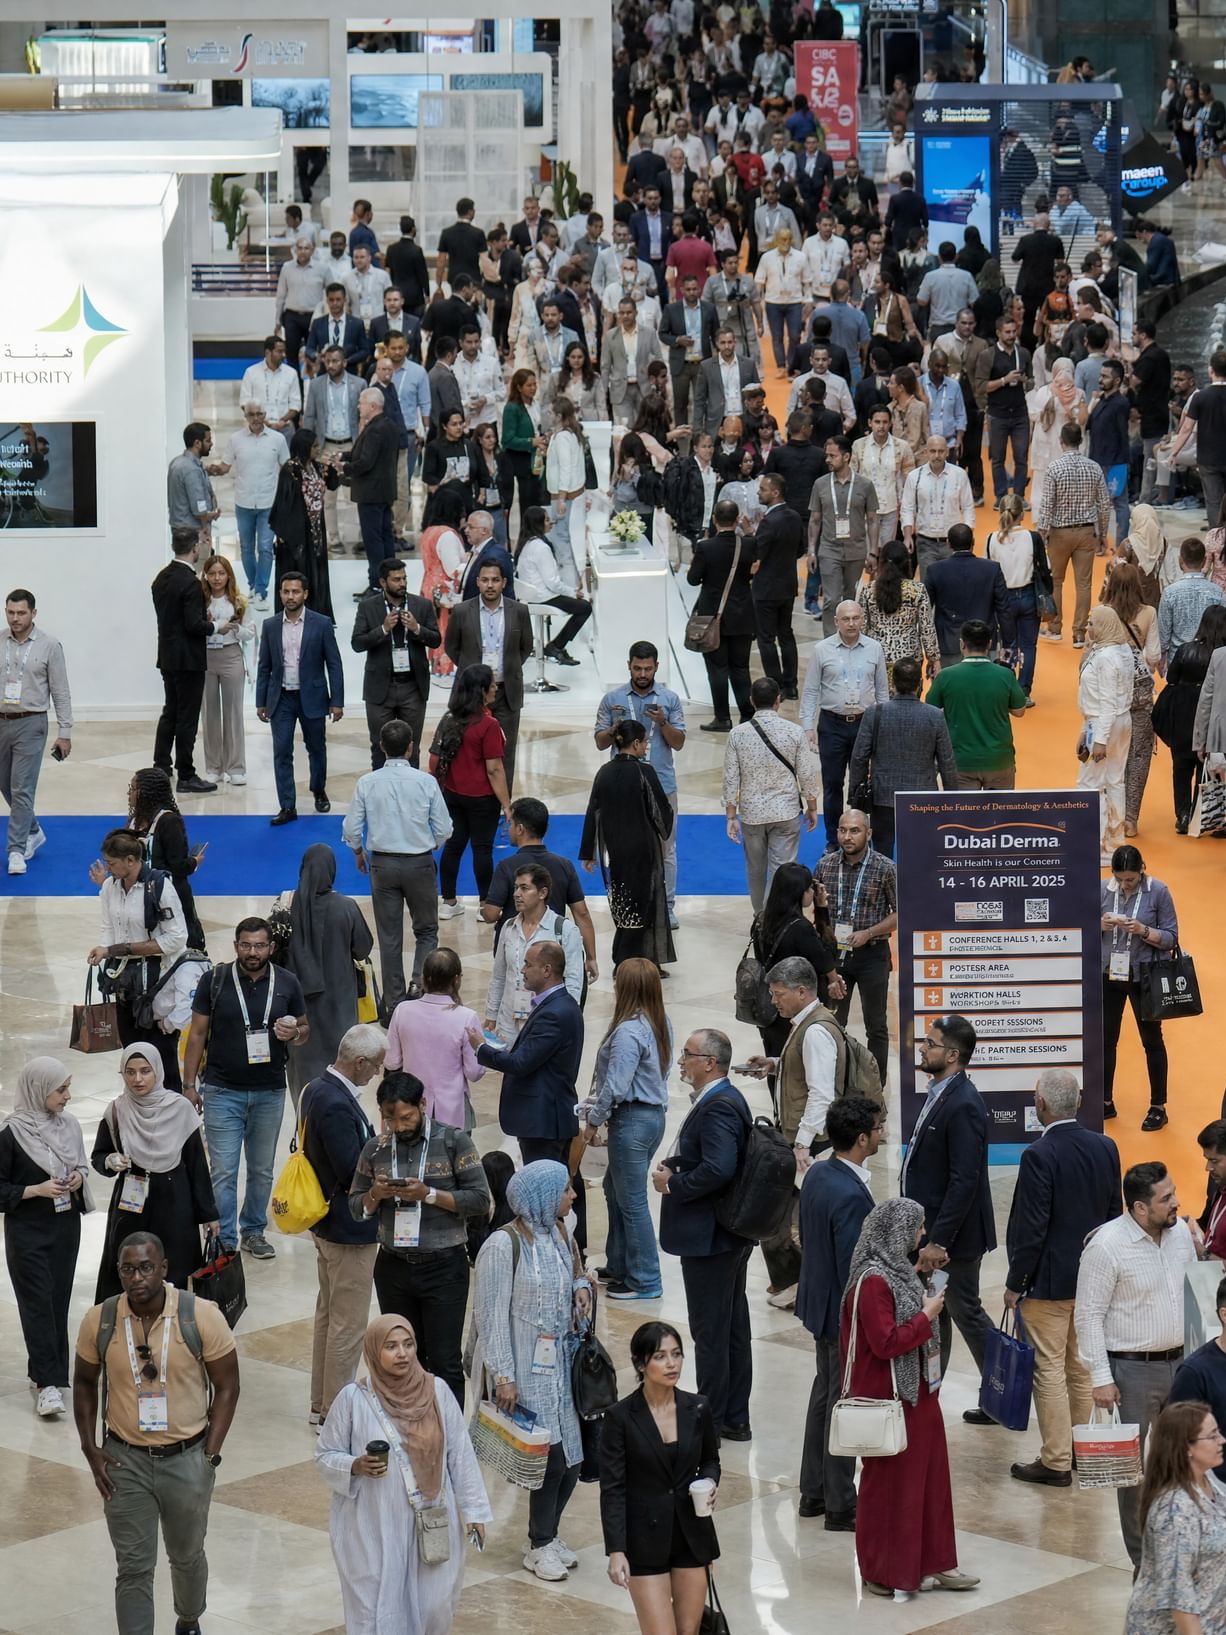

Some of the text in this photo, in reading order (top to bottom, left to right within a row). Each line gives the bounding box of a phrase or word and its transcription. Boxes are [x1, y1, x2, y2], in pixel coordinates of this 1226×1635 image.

[1121, 166, 1164, 180] maeen
[909, 803, 939, 813] Shaping
[955, 803, 980, 811] Future
[982, 803, 991, 811] of
[992, 802, 1041, 812] Dermatology
[1051, 801, 1089, 810] Aesthetics
[944, 834, 1059, 849] Dubai Derma
[943, 859, 962, 867] Skin
[964, 859, 993, 867] Health
[939, 877, 956, 888] 14
[969, 877, 986, 888] 16
[989, 876, 1028, 887] APRIL
[1031, 875, 1066, 887] 2025
[949, 936, 1001, 944] CONFERENCE
[1004, 935, 1029, 943] HALLS
[996, 990, 1021, 998] HALLS
[988, 1046, 1026, 1054] PARTNER
[1029, 1045, 1067, 1053] SESSIONS
